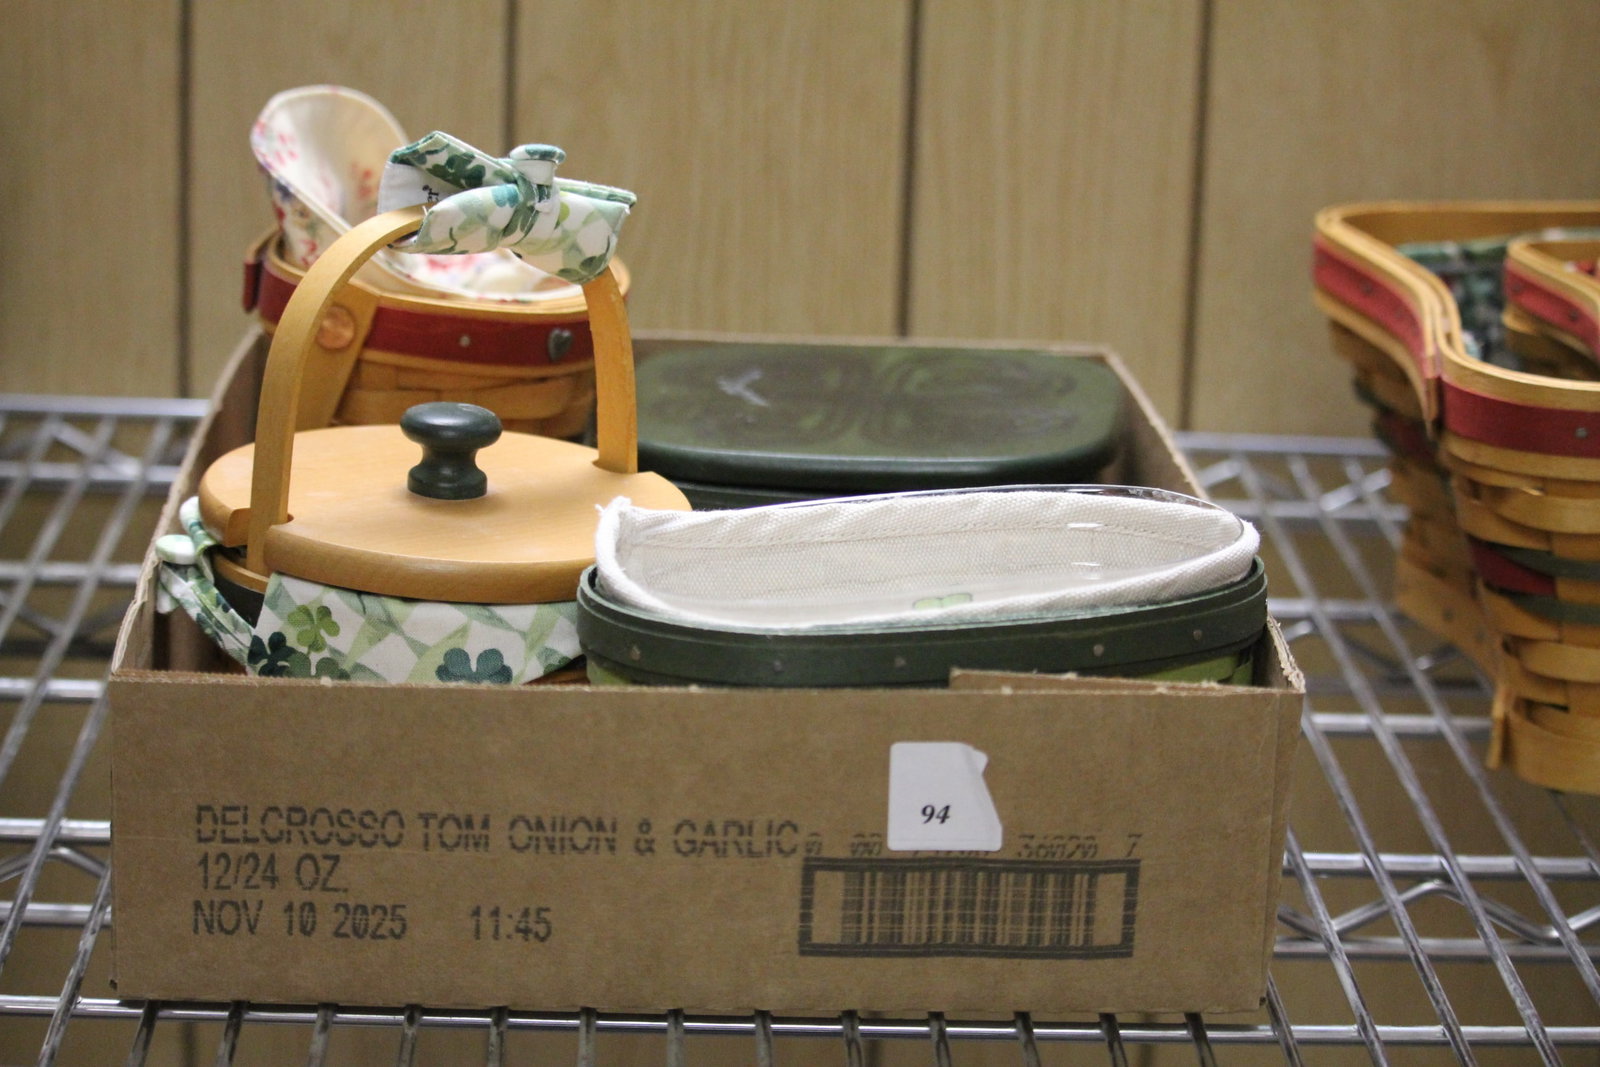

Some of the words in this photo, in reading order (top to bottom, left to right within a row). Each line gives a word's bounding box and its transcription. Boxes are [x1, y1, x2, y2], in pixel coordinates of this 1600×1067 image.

[417, 812, 491, 852] TOM
[508, 814, 618, 856] ONION
[634, 818, 656, 857] &
[673, 819, 799, 858] GARLIC
[920, 804, 951, 825] 94
[198, 851, 279, 890] 12/24
[193, 899, 264, 937] NOV
[284, 901, 317, 937] 10
[333, 902, 408, 941] 2025
[470, 905, 553, 942] 11:45
